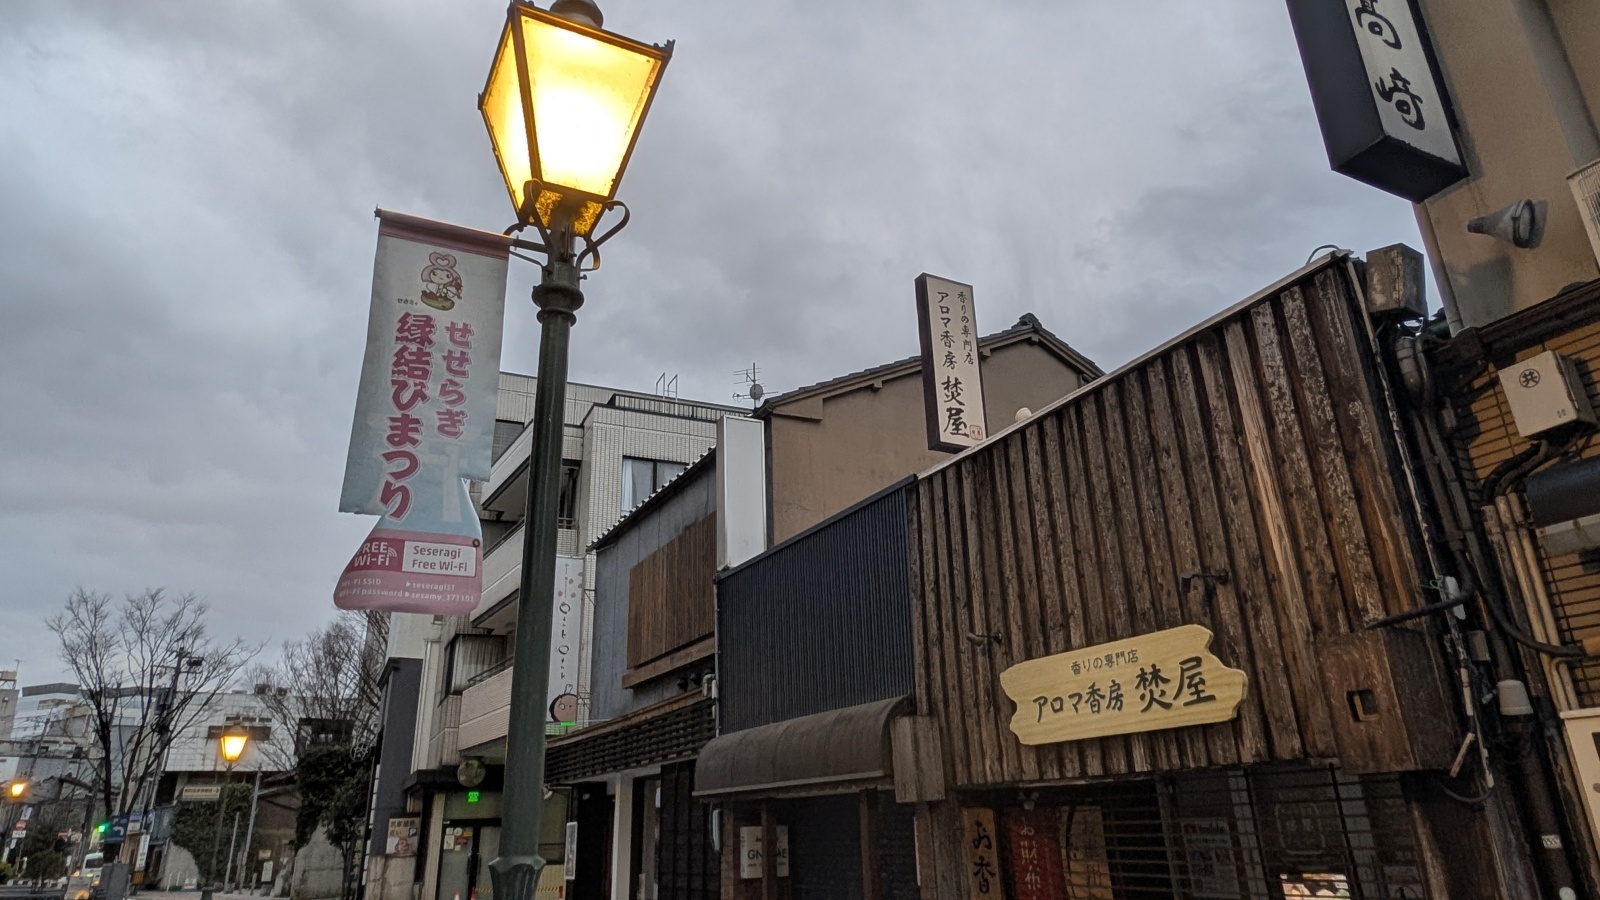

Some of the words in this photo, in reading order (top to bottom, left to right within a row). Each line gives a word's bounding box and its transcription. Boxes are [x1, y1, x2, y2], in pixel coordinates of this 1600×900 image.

[937, 291, 958, 370] アロマ香房
[957, 291, 974, 365] 香りの専門店
[436, 321, 475, 439] せせらぎ
[941, 375, 970, 439] 焚屋
[380, 311, 437, 521] 縁結びまつり
[354, 553, 390, 567] Wi-Fi
[412, 559, 437, 570] Free
[439, 560, 468, 572] Wi-Fi
[413, 545, 461, 559] Seseragi
[361, 588, 403, 597] password
[1032, 679, 1124, 723] アロマ香房
[1135, 656, 1217, 713] 焚屋
[1070, 649, 1139, 676] 香りの専門店
[747, 848, 787, 860] GNME
[973, 820, 997, 894] お香
